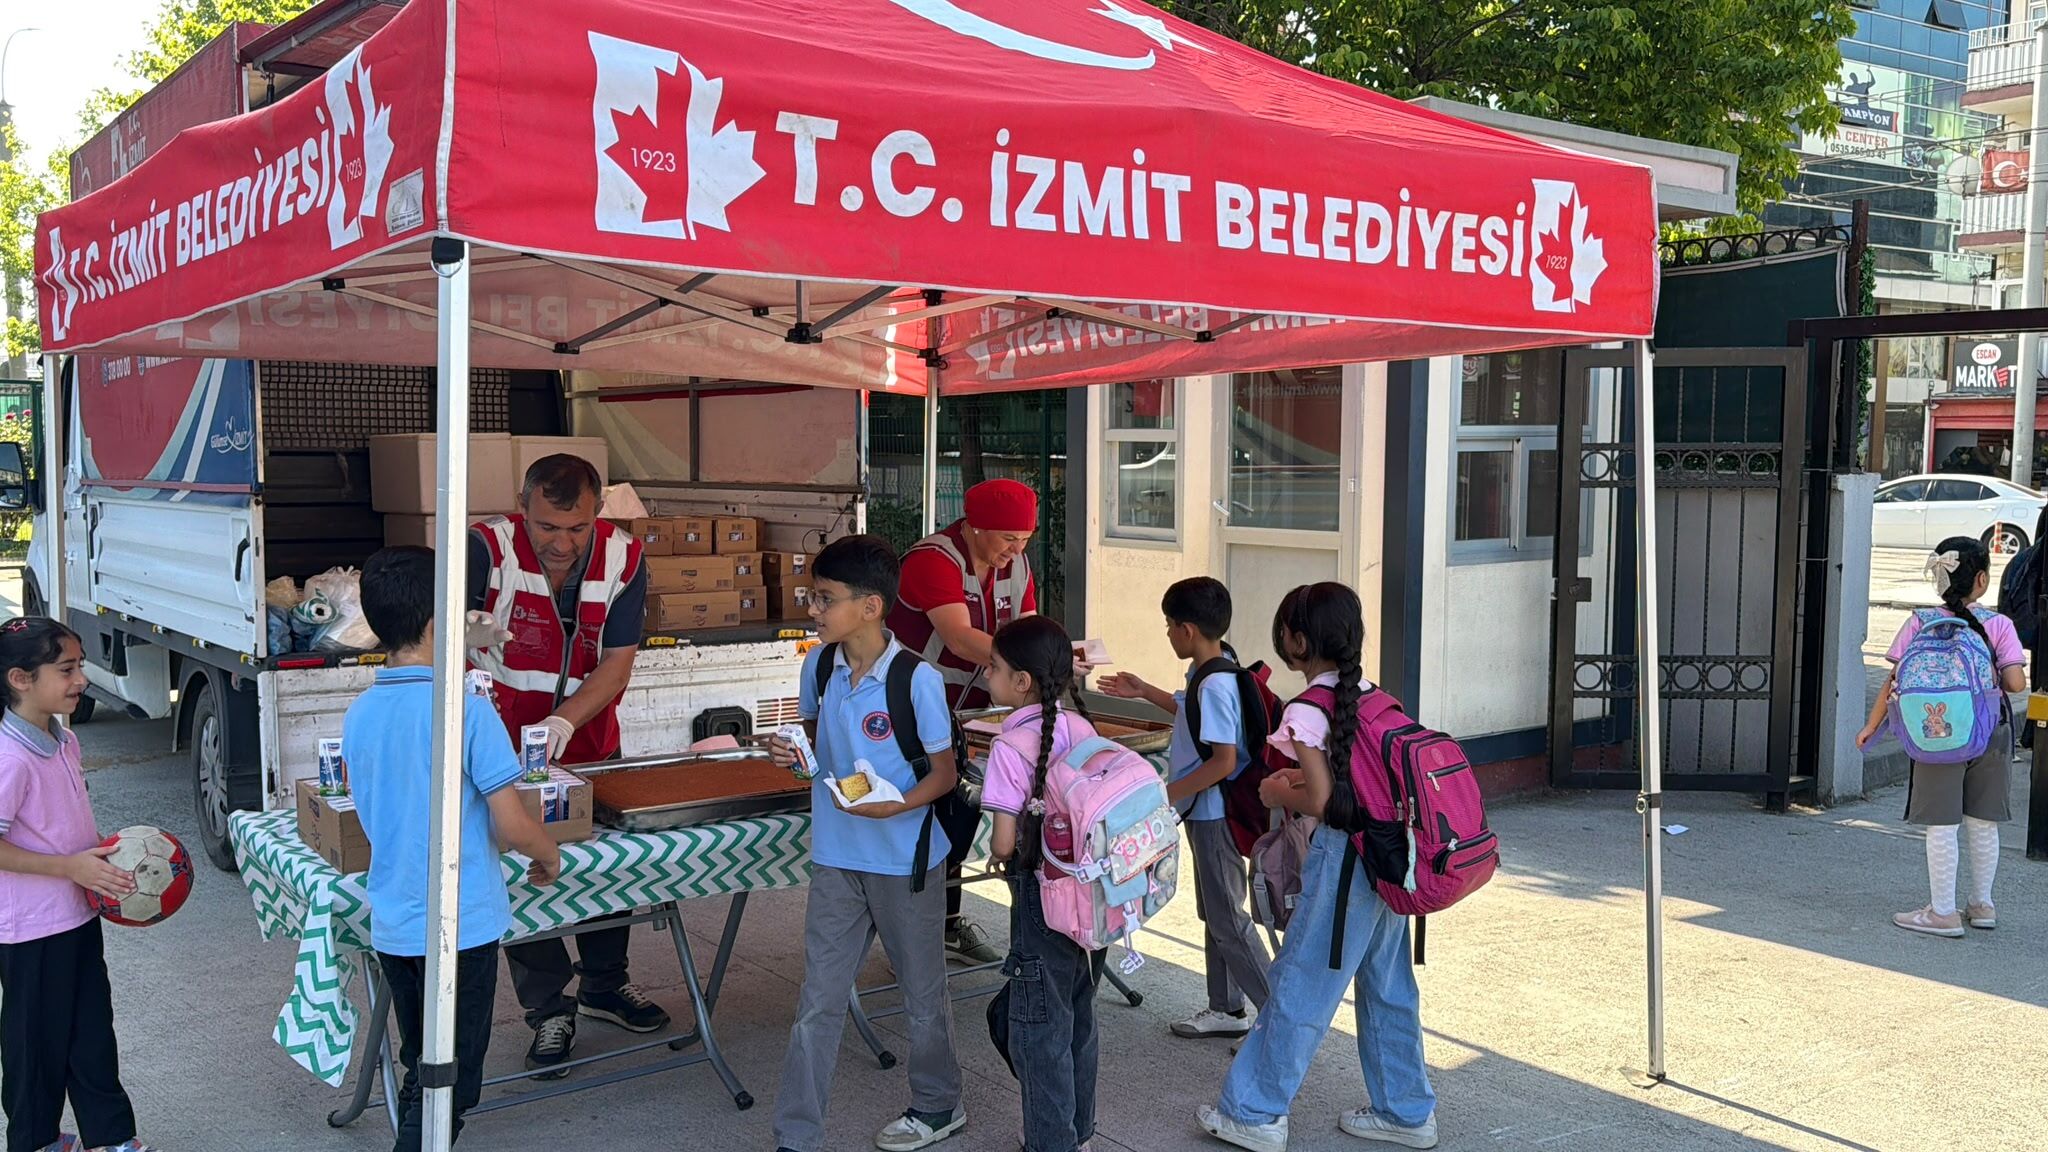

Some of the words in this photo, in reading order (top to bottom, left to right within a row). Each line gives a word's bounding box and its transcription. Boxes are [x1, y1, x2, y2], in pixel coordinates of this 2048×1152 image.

[1830, 143, 1849, 154] 0535
[1846, 130, 1889, 148] CENTER
[345, 157, 363, 183] 1923
[630, 147, 676, 173] 1923
[70, 241, 114, 304] T.C.
[109, 198, 171, 293] İZMİT
[176, 105, 330, 268] BELEDİYESİ
[775, 110, 963, 223] T.C.
[990, 128, 1191, 242] İZMİT
[1215, 180, 1526, 277] BELEDİYESİ
[1546, 255, 1568, 270] 1923
[1976, 349, 1997, 359] ESCAN
